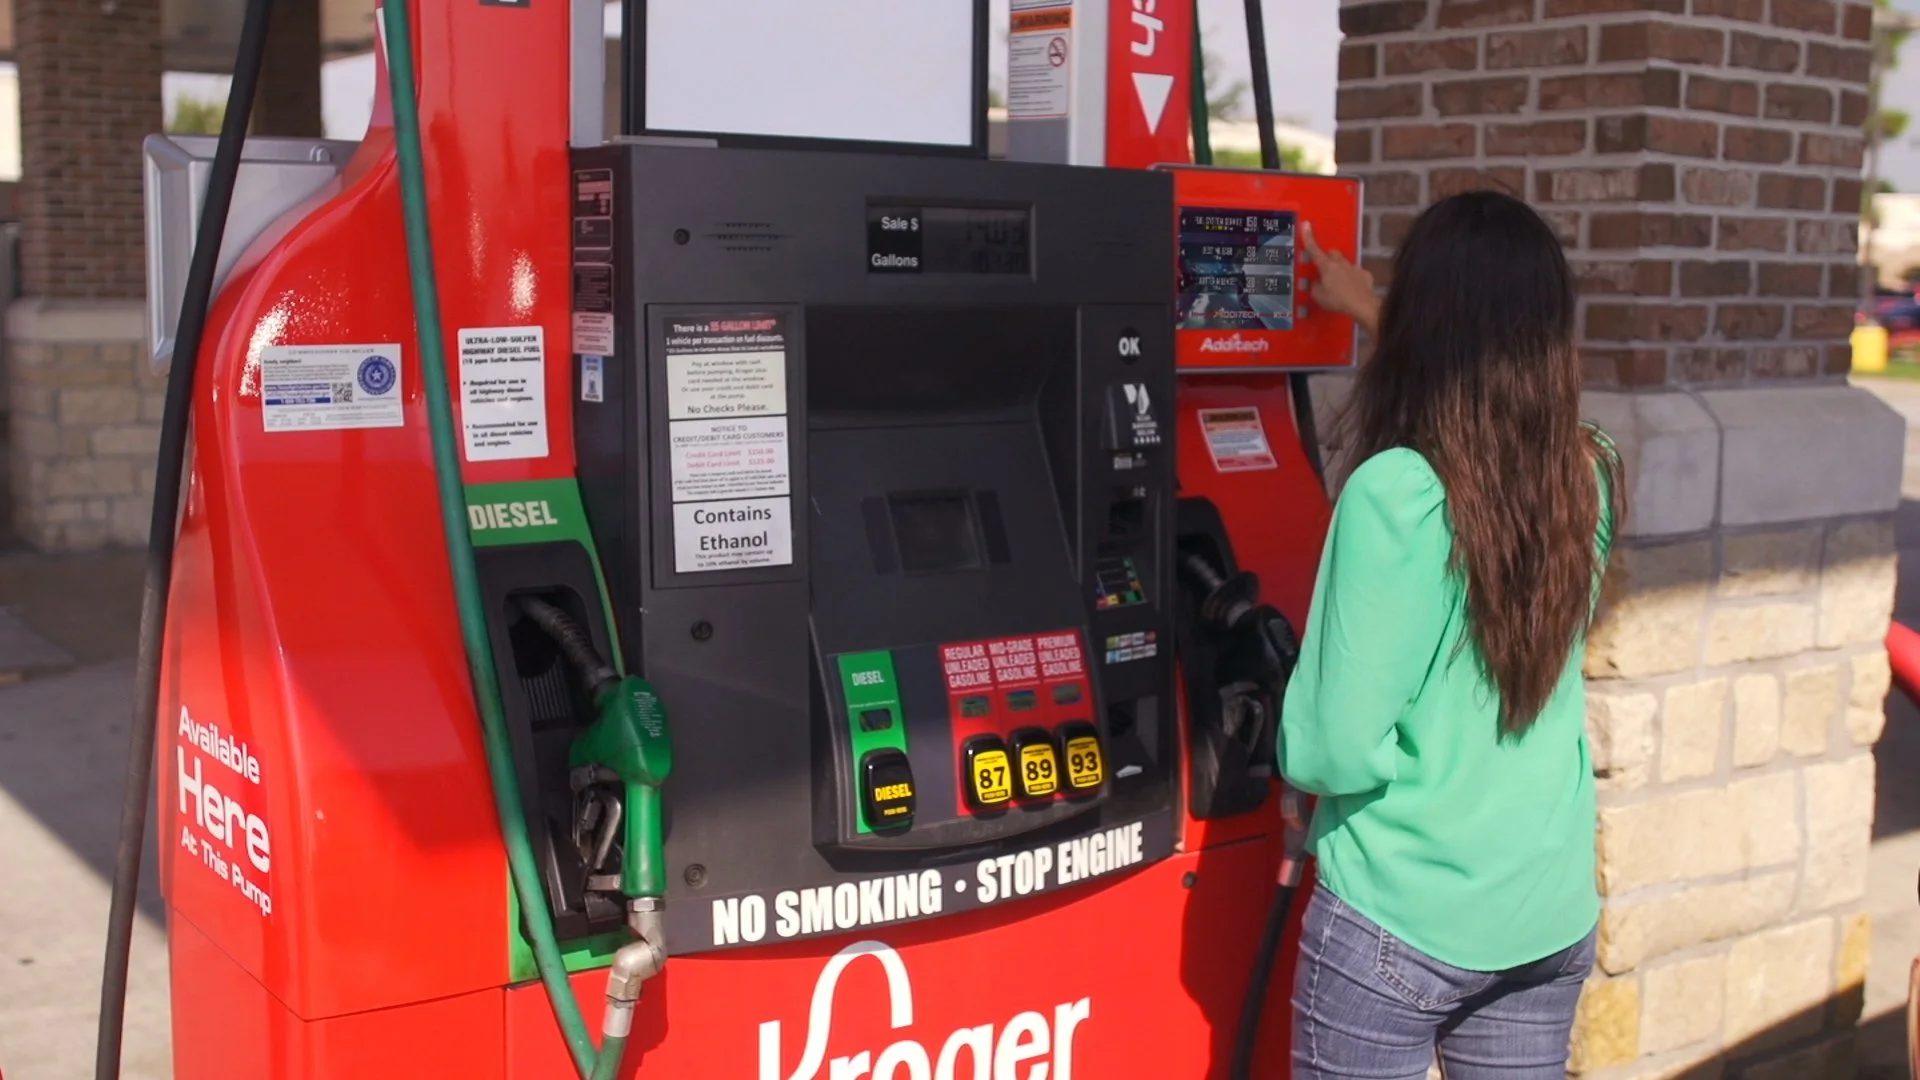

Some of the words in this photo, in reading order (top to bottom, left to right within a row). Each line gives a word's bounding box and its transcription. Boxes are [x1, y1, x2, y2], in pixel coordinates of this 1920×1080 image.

[882, 217, 908, 230] Sale
[911, 218, 918, 231] $
[872, 253, 918, 267] Gallons
[673, 324, 695, 333] There
[696, 323, 703, 332] is
[721, 321, 751, 331] GALLON
[672, 336, 691, 345] vehicle
[692, 337, 702, 346] per
[704, 335, 735, 344] transaction
[744, 334, 755, 342] fuel
[1119, 337, 1140, 355] OK
[1200, 332, 1268, 352] Additech
[688, 405, 700, 414] No
[703, 403, 735, 412] Checks
[737, 402, 769, 411] Please.
[472, 421, 516, 429] Recommended
[673, 434, 720, 443] CREDIT/DEBIT
[685, 451, 706, 459] Credit
[708, 450, 723, 458] Card
[686, 461, 706, 469] Debit
[707, 460, 722, 468] Card
[468, 501, 558, 530] DIESEL
[694, 506, 772, 524] Contains
[700, 531, 768, 550] Ethanol
[989, 639, 1034, 655] MID-GRADE
[1037, 634, 1076, 649] PREMIUM
[944, 644, 985, 660] REGULAR
[992, 652, 1036, 668] UNLEADED
[1039, 647, 1081, 663] UNLEADED
[945, 658, 990, 674] UNLEADED
[996, 665, 1037, 682] GASOLINE
[1042, 660, 1082, 676] GASOLINE
[852, 670, 885, 686] DIESEL
[949, 671, 992, 688] GASOLINE
[179, 705, 260, 784] Available
[1026, 759, 1053, 781] 89
[1071, 752, 1097, 774] 93
[980, 766, 1005, 789] 87
[875, 783, 912, 801] DIESEL
[177, 745, 270, 873] Here
[181, 825, 198, 856] At
[201, 839, 228, 880] This
[232, 863, 272, 916] Pump
[712, 895, 766, 945] NO
[775, 869, 942, 937] SMOKING
[977, 847, 1052, 903] STOP
[1058, 821, 1143, 885] ENGINE
